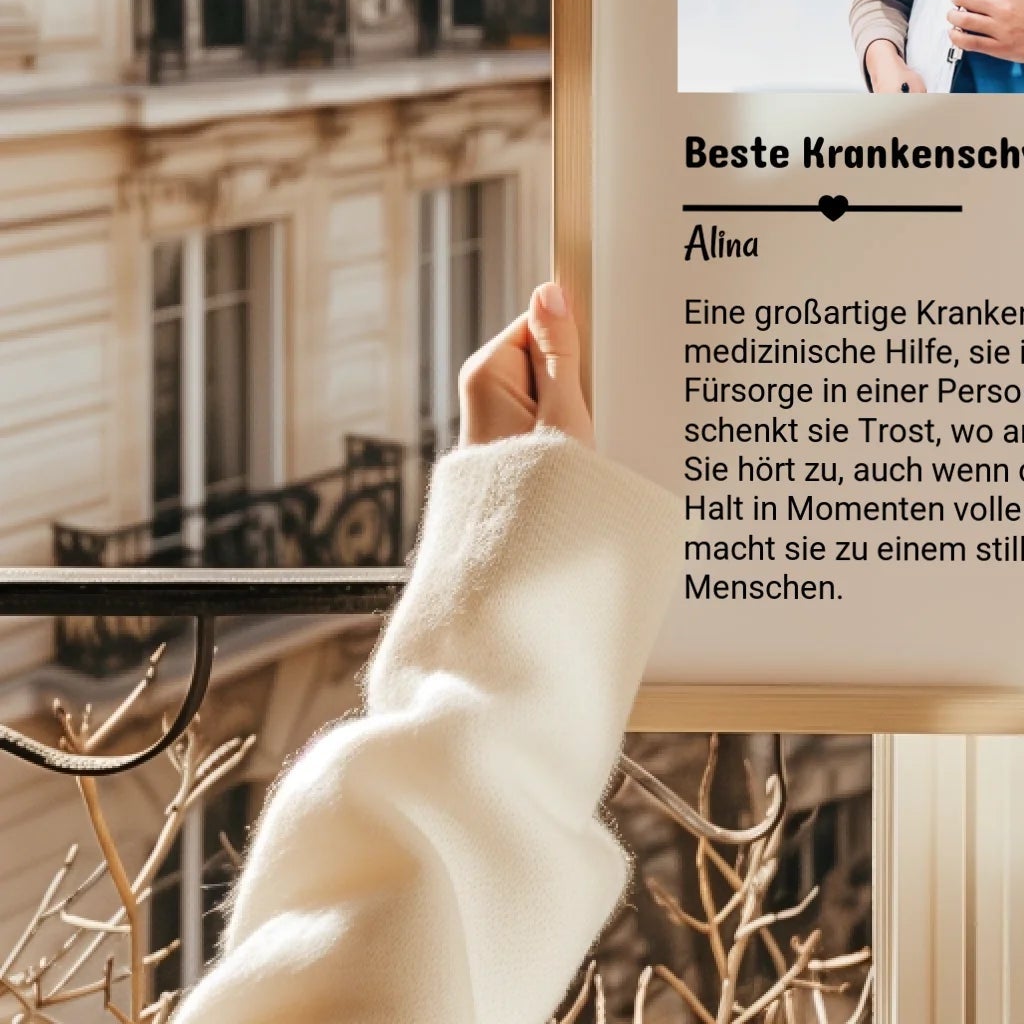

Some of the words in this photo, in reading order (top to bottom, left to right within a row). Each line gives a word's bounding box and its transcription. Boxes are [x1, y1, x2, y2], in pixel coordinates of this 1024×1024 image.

[685, 135, 790, 169] Beste
[683, 223, 759, 262] Alina
[685, 298, 746, 325] Eine
[754, 297, 907, 332] großartige
[684, 337, 876, 364] medizinische
[886, 337, 959, 369] Hilfe,
[969, 338, 1010, 365] sie
[685, 376, 813, 410] Fürsorge
[823, 377, 847, 403] in
[856, 377, 929, 404] einer
[684, 416, 799, 443] schenkt
[808, 417, 849, 443] sie
[857, 417, 941, 448] Trost,
[950, 423, 994, 444] wo
[684, 455, 729, 482] Sie
[738, 455, 796, 482] hört
[804, 462, 844, 486] zu,
[853, 455, 923, 483] auch
[931, 462, 1009, 483] wenn
[685, 494, 744, 521] Halt
[753, 495, 777, 521] in
[788, 495, 944, 522] Momenten
[684, 534, 776, 561] macht
[785, 535, 826, 561] sie
[835, 541, 868, 561] zu
[877, 535, 966, 562] einem
[685, 573, 843, 600] Menschen.
